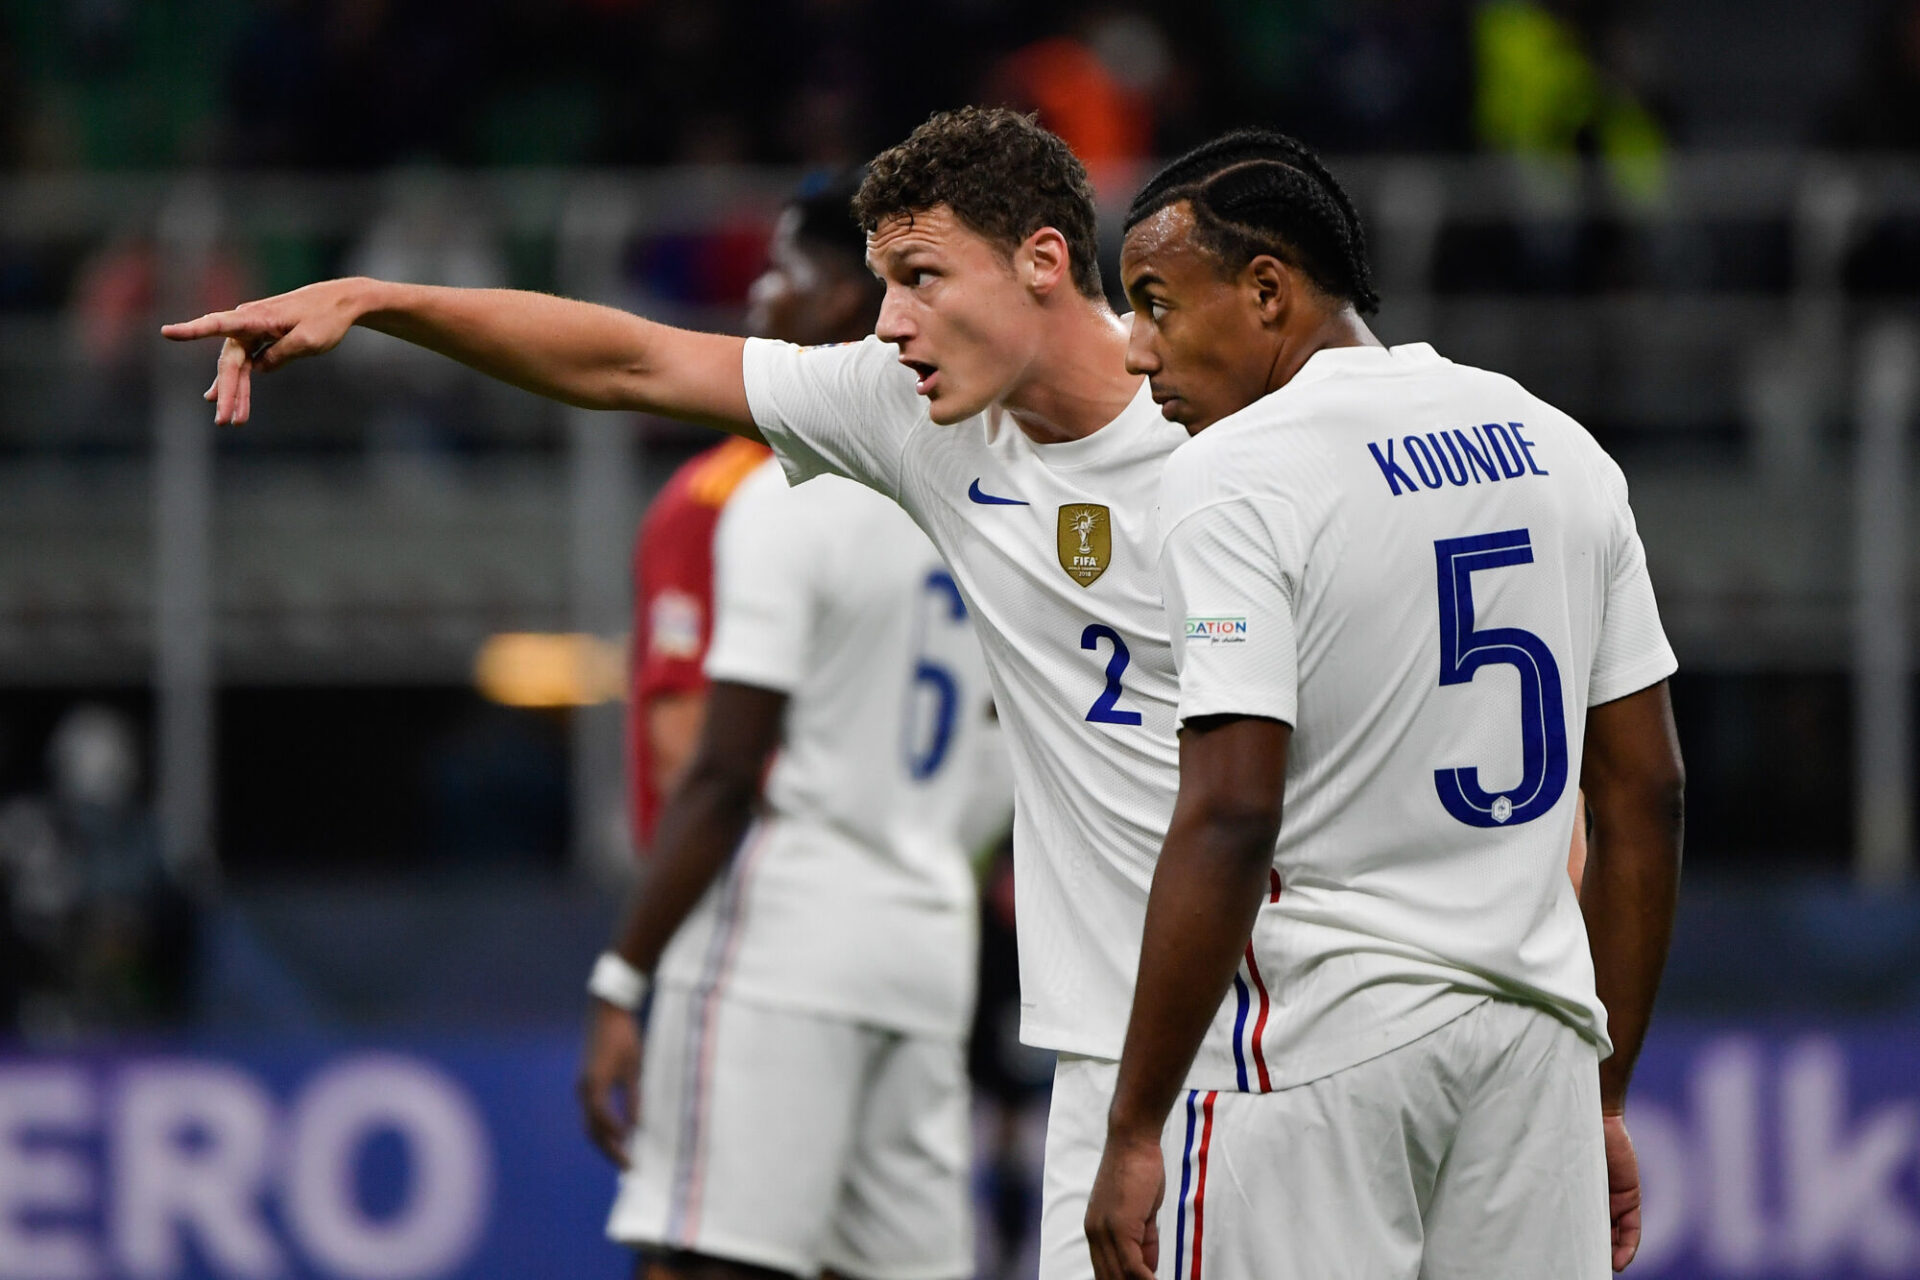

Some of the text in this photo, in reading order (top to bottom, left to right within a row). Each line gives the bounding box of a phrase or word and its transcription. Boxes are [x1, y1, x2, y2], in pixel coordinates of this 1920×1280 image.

[1367, 421, 1549, 496] KOUNDE
[1073, 556, 1097, 566] FIFA
[905, 567, 968, 782] 6
[1081, 623, 1142, 727] 2
[1434, 528, 1569, 828] 5
[0, 1054, 492, 1280] ERO
